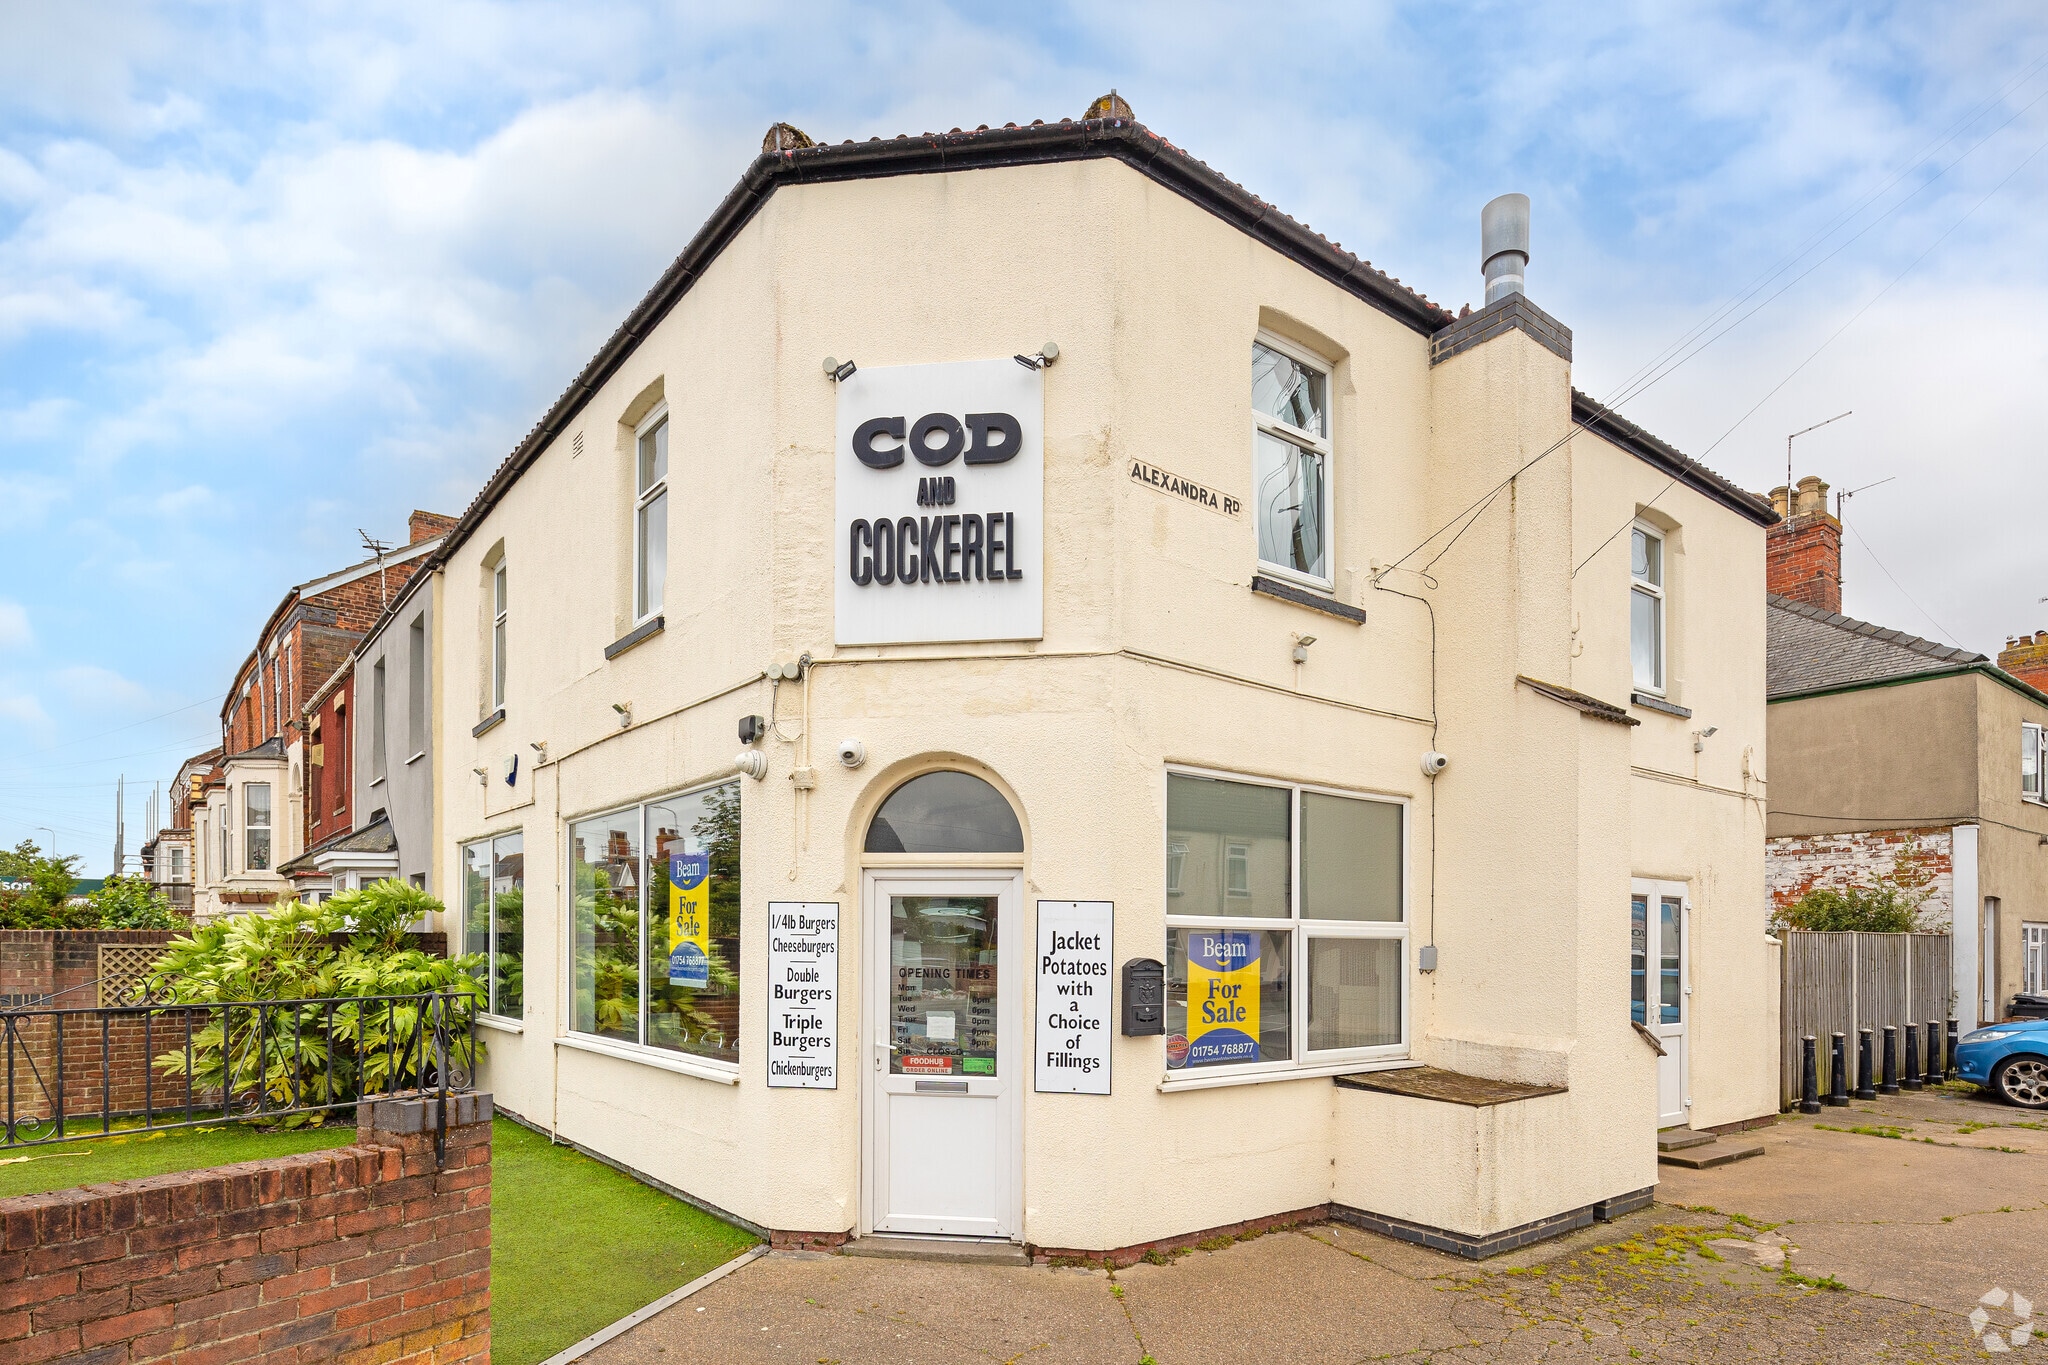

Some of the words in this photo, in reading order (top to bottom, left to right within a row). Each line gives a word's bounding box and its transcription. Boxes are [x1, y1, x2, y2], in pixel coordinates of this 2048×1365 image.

[852, 412, 1023, 469] COD
[916, 476, 956, 506] AND
[1131, 462, 1218, 509] ALEXANDRA
[1223, 496, 1240, 515] RD
[850, 512, 1023, 586] COCKEREL
[676, 860, 700, 878] Beam
[679, 896, 698, 914] For
[676, 915, 700, 936] Sale
[799, 914, 836, 934] Burgers
[772, 937, 835, 957] Cheeseburgers
[1050, 930, 1101, 955] Jacket
[1203, 937, 1247, 957] Beam
[671, 955, 686, 965] 01754
[1042, 955, 1107, 976] Potatoes
[787, 967, 819, 982] Double
[899, 968, 950, 978] OPENING
[956, 969, 991, 979] TIMES
[774, 984, 832, 1004] Burgers
[1056, 980, 1093, 996] with
[1207, 978, 1242, 999] For
[1069, 1000, 1079, 1012] a
[1202, 1000, 1247, 1024] Sale
[782, 1013, 823, 1034] Triple
[1048, 1013, 1100, 1030] Choice
[773, 1031, 831, 1052] Burgers
[1065, 1034, 1082, 1049] of
[1192, 1045, 1219, 1057] 01754
[1221, 1042, 1254, 1055] 768877
[771, 1060, 832, 1081] Chickenburgers
[910, 1057, 944, 1065] FOODHUB
[1047, 1052, 1100, 1074] Fillings
